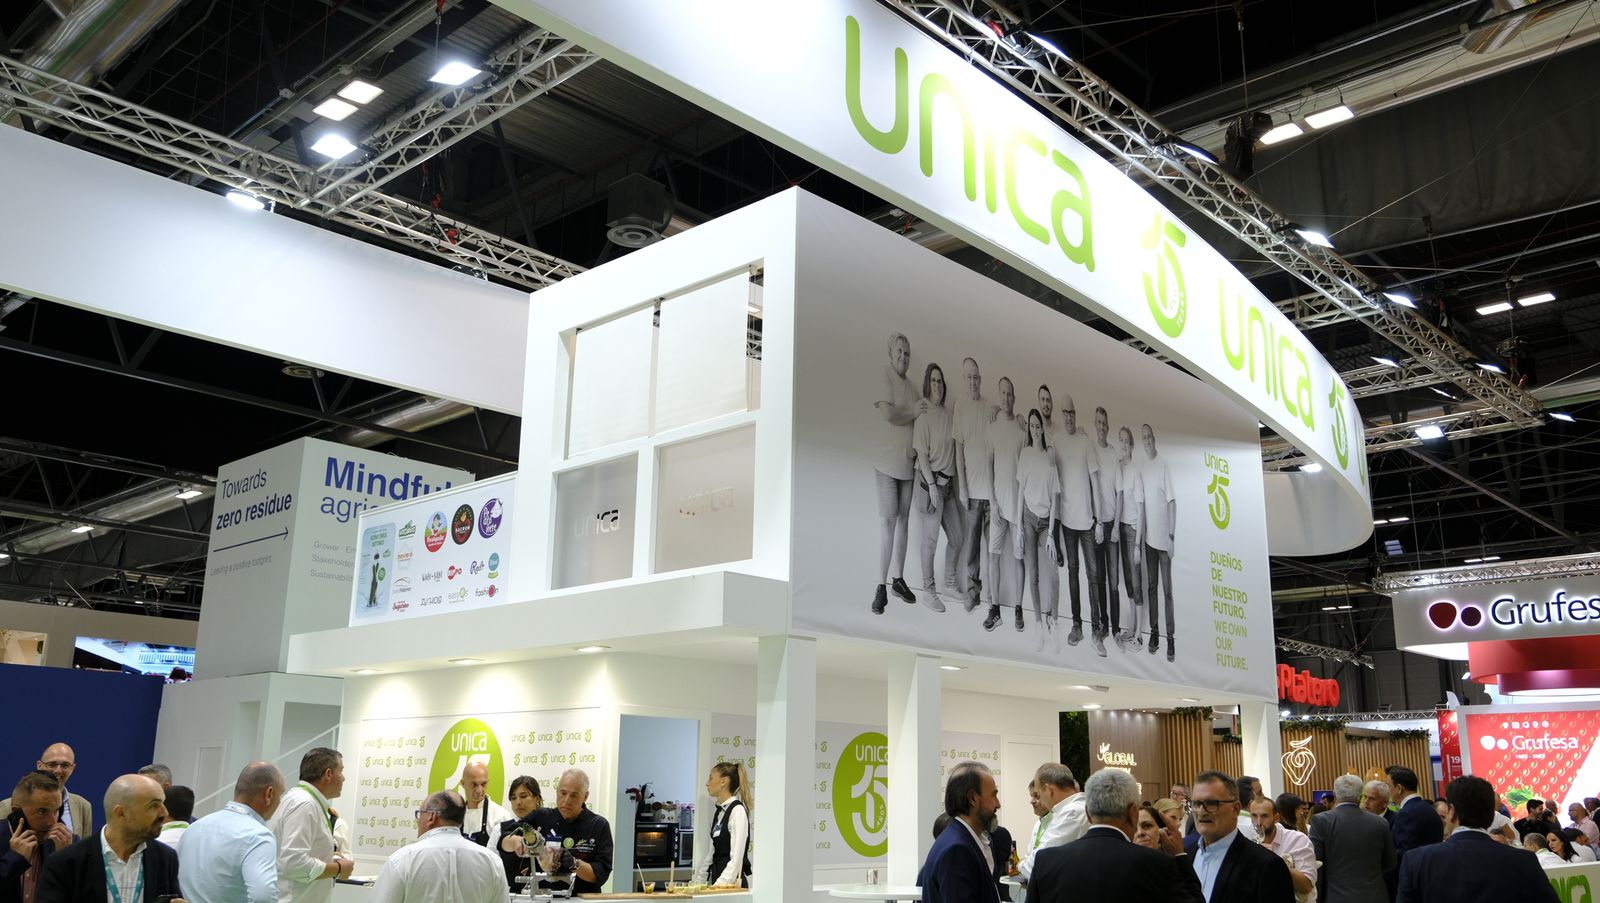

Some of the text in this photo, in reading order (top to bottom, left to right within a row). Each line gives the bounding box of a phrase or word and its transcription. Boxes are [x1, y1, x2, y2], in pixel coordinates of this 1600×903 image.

[845, 15, 1095, 272] unica
[1217, 276, 1315, 432] unica
[1204, 452, 1229, 475] unica
[222, 468, 267, 499] Towards
[216, 493, 292, 530] zero residue
[1210, 551, 1243, 572] DUEÑOS
[1211, 568, 1223, 582] DE
[1212, 584, 1248, 604] NUESTRO
[1213, 601, 1247, 620] FUTURO.
[1214, 620, 1248, 638] WE OWN
[1215, 636, 1232, 651] OUR
[1216, 653, 1249, 672] FUTURE.
[451, 732, 488, 752] unica
[1512, 732, 1579, 751] Grufesa
[1103, 752, 1137, 766] GLOBAL
